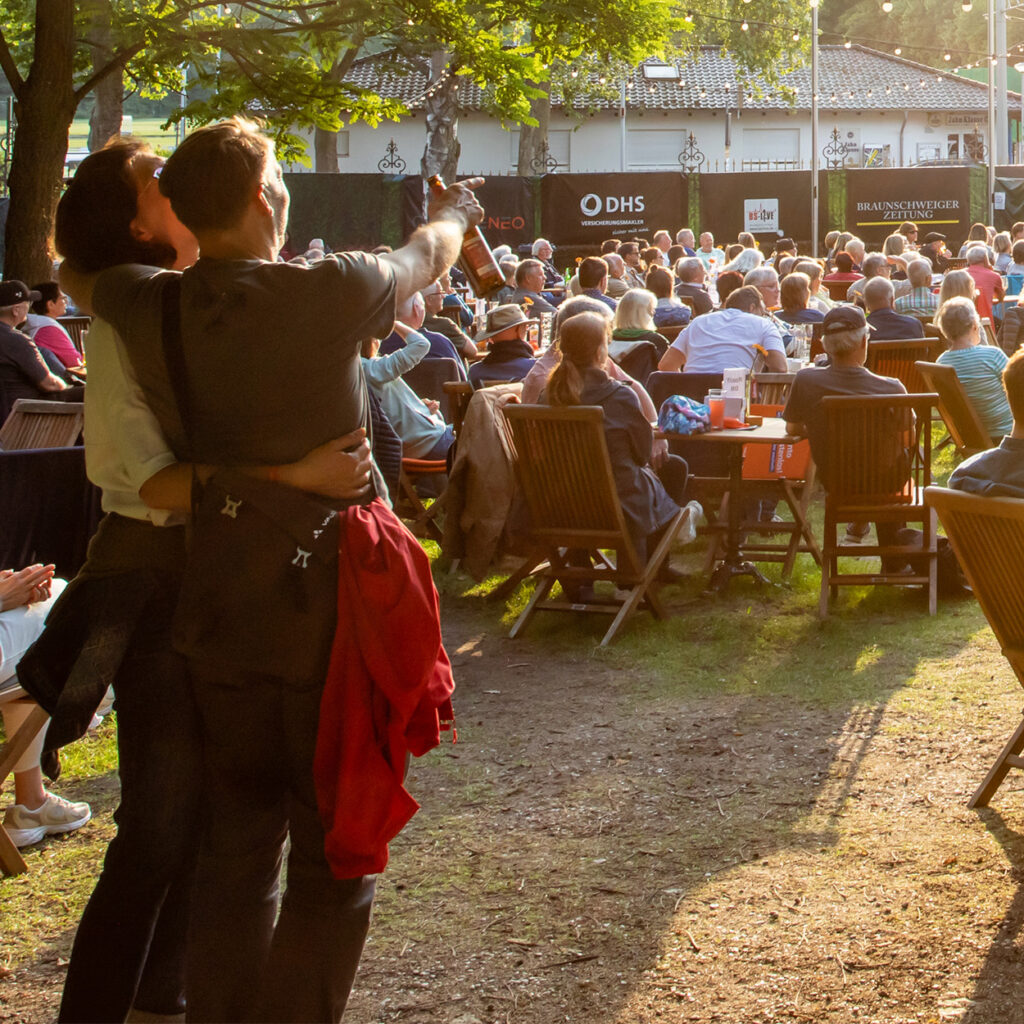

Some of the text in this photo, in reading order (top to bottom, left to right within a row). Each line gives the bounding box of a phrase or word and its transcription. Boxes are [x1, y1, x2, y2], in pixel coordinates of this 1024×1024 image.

[606, 195, 645, 213] DHS
[856, 200, 960, 212] BRAUNSCHWEIGER
[883, 210, 934, 220] ZEITUNG
